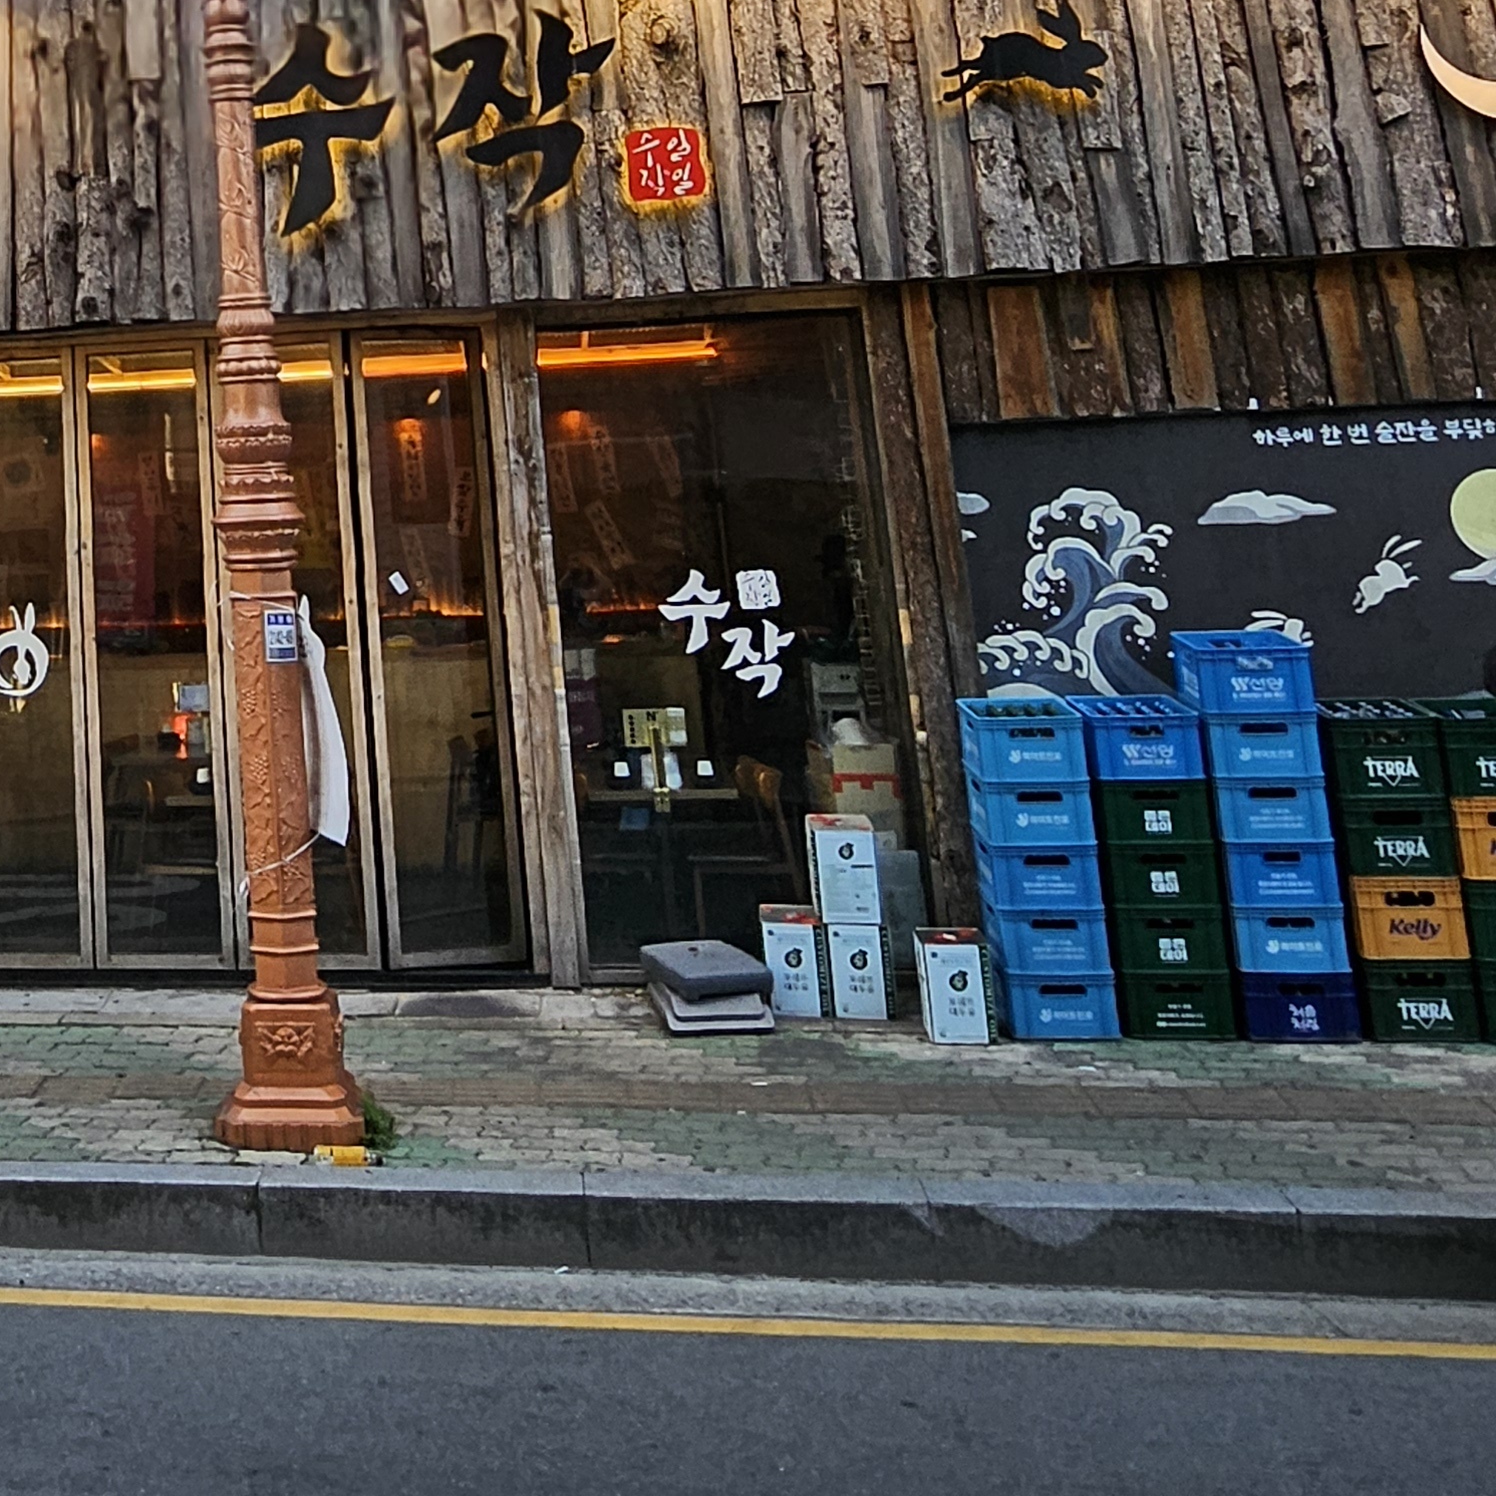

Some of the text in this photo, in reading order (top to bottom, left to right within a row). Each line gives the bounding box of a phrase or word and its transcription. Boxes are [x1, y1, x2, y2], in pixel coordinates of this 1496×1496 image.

[252, 9, 617, 237] 수작
[1252, 426, 1314, 448] 하루에
[1319, 423, 1343, 446] 한
[1346, 422, 1371, 445] 번
[1375, 418, 1439, 444] 술잔을
[657, 568, 796, 699] 수작
[1363, 755, 1420, 780] TERRA
[1374, 835, 1431, 859] TERRA
[1389, 918, 1442, 941] Kelly
[1397, 997, 1454, 1022] TERRA
